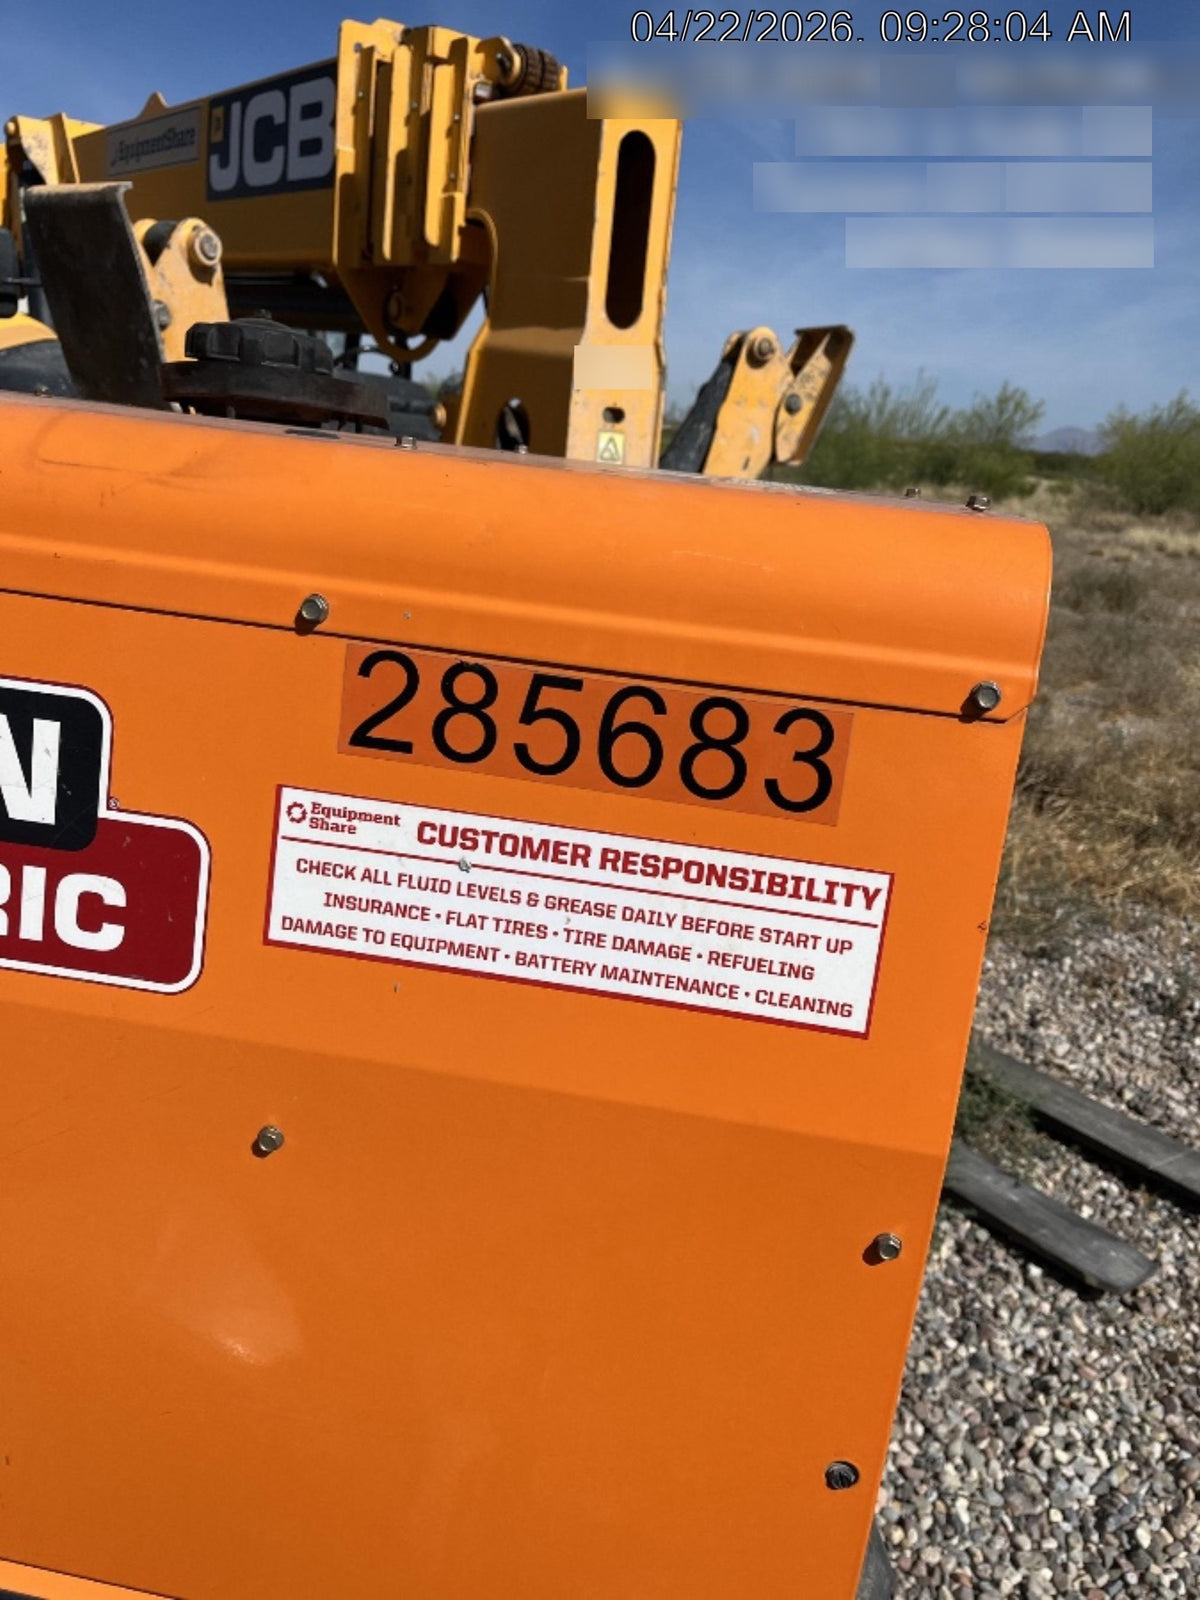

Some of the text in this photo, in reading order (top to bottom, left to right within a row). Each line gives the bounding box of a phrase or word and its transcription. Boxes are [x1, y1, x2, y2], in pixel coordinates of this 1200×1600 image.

[209, 76, 336, 192] JCB
[347, 649, 835, 814] 285683
[308, 816, 357, 835] Share
[310, 801, 883, 911] Equipment CUSTOMER RESPONSIBILITY
[0, 862, 127, 952] IC
[296, 858, 854, 956] CHECK ALL FLUID LEVELS & GREASE DAILY BEFORE START UP
[323, 891, 815, 981] INSURANCE FLAT TIRES TIRE DAMAGE REFUELING
[281, 915, 853, 1018] DAMAGE TO EQUIPMENT BATTERY MAINTENANCE CLEANING
